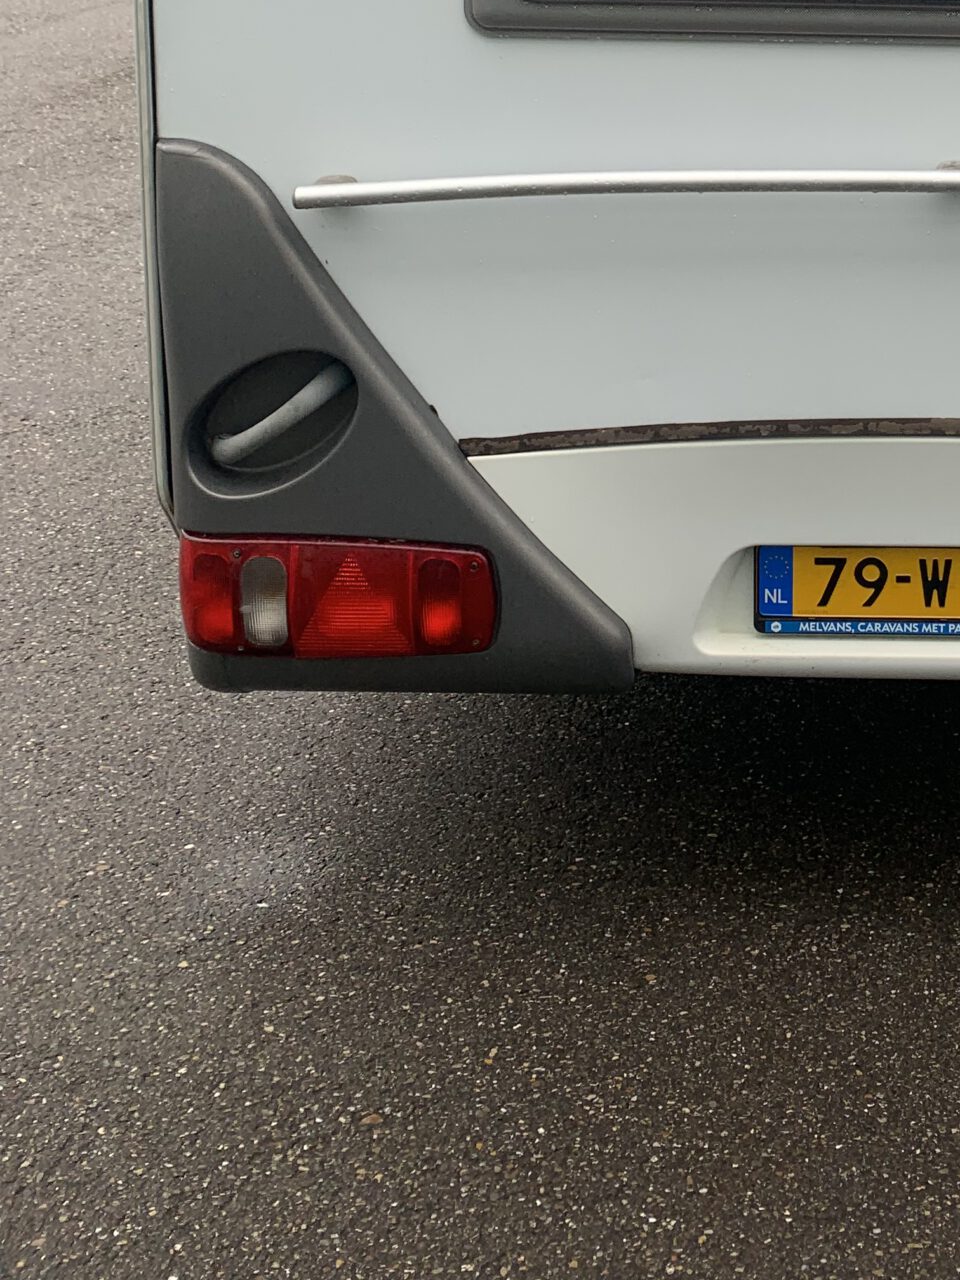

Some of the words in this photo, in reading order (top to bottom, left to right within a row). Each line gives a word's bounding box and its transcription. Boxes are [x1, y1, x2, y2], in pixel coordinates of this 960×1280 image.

[764, 588, 788, 604] NL
[798, 621, 855, 634] MELVANS,
[857, 622, 918, 633] CARAVANS
[921, 623, 946, 633] MET
